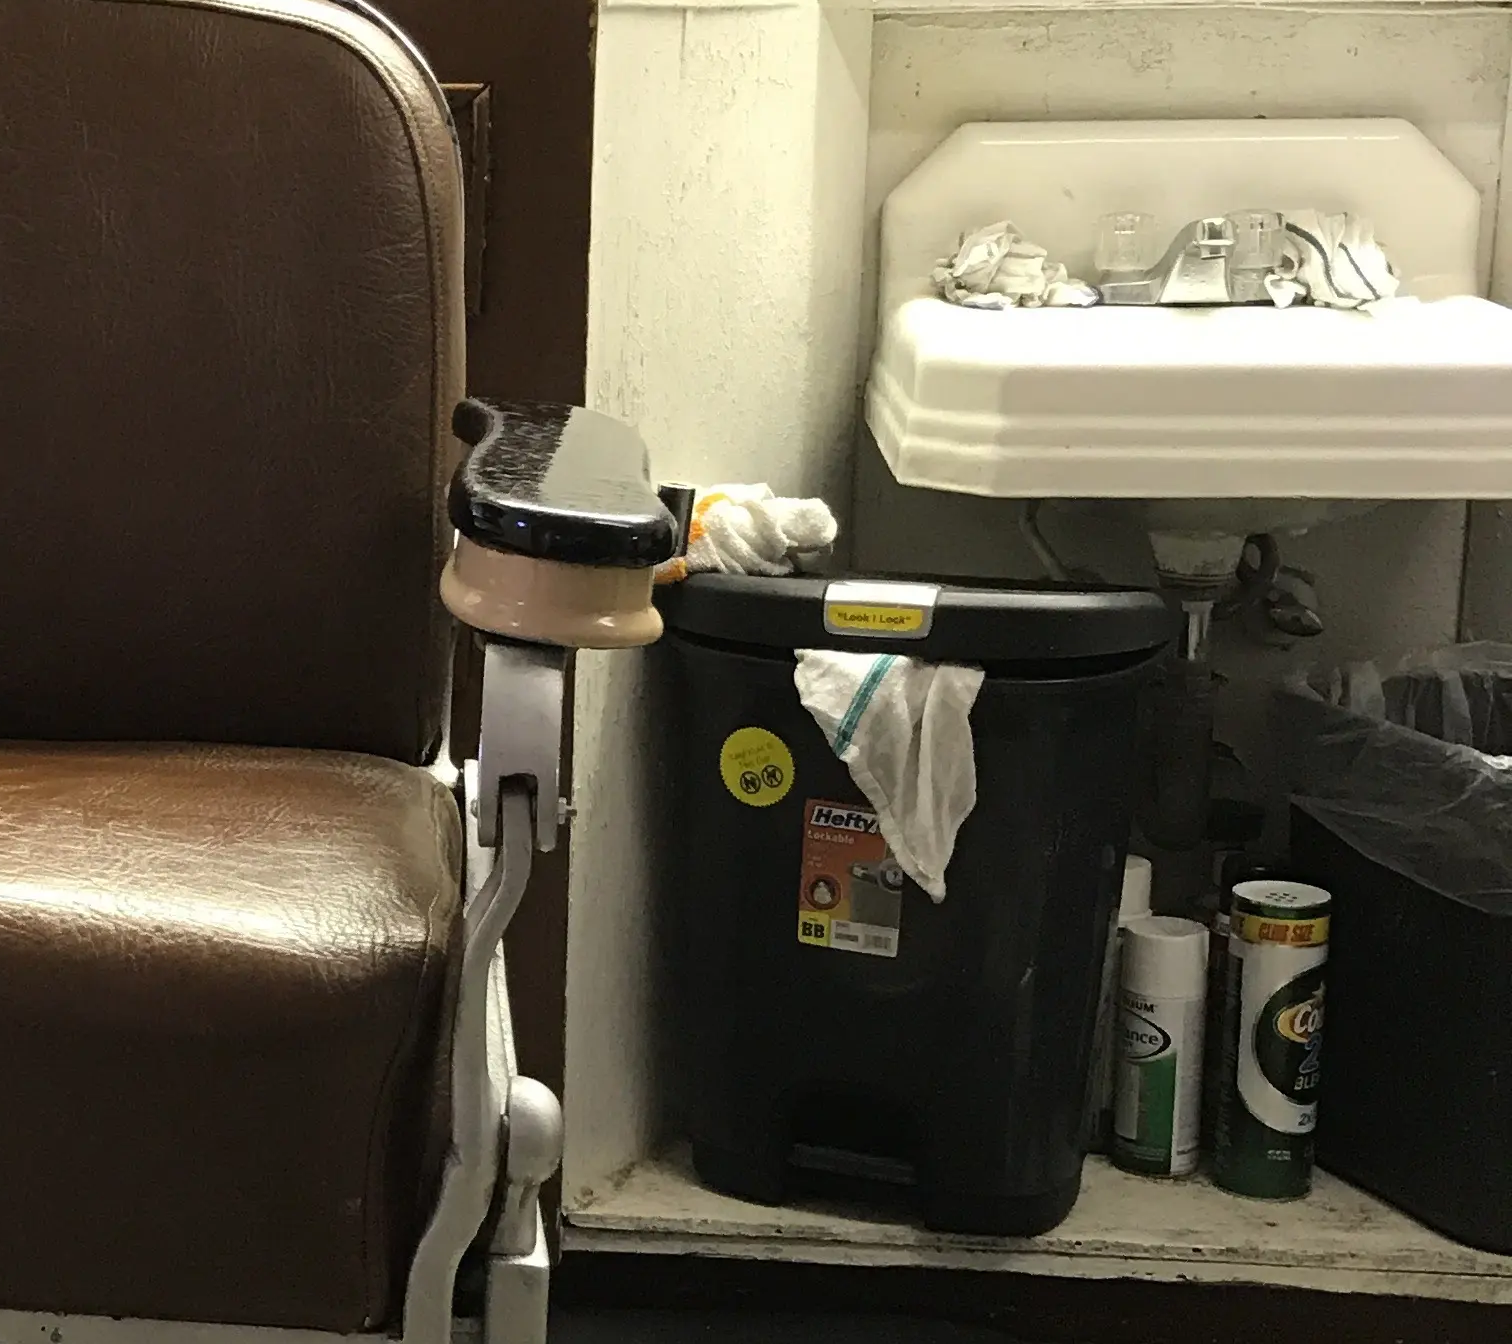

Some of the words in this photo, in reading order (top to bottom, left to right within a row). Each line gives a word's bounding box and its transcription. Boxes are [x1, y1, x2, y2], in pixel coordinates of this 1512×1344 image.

[813, 807, 878, 834] Hefty
[807, 829, 855, 845] Lockable
[801, 920, 826, 940] BB
